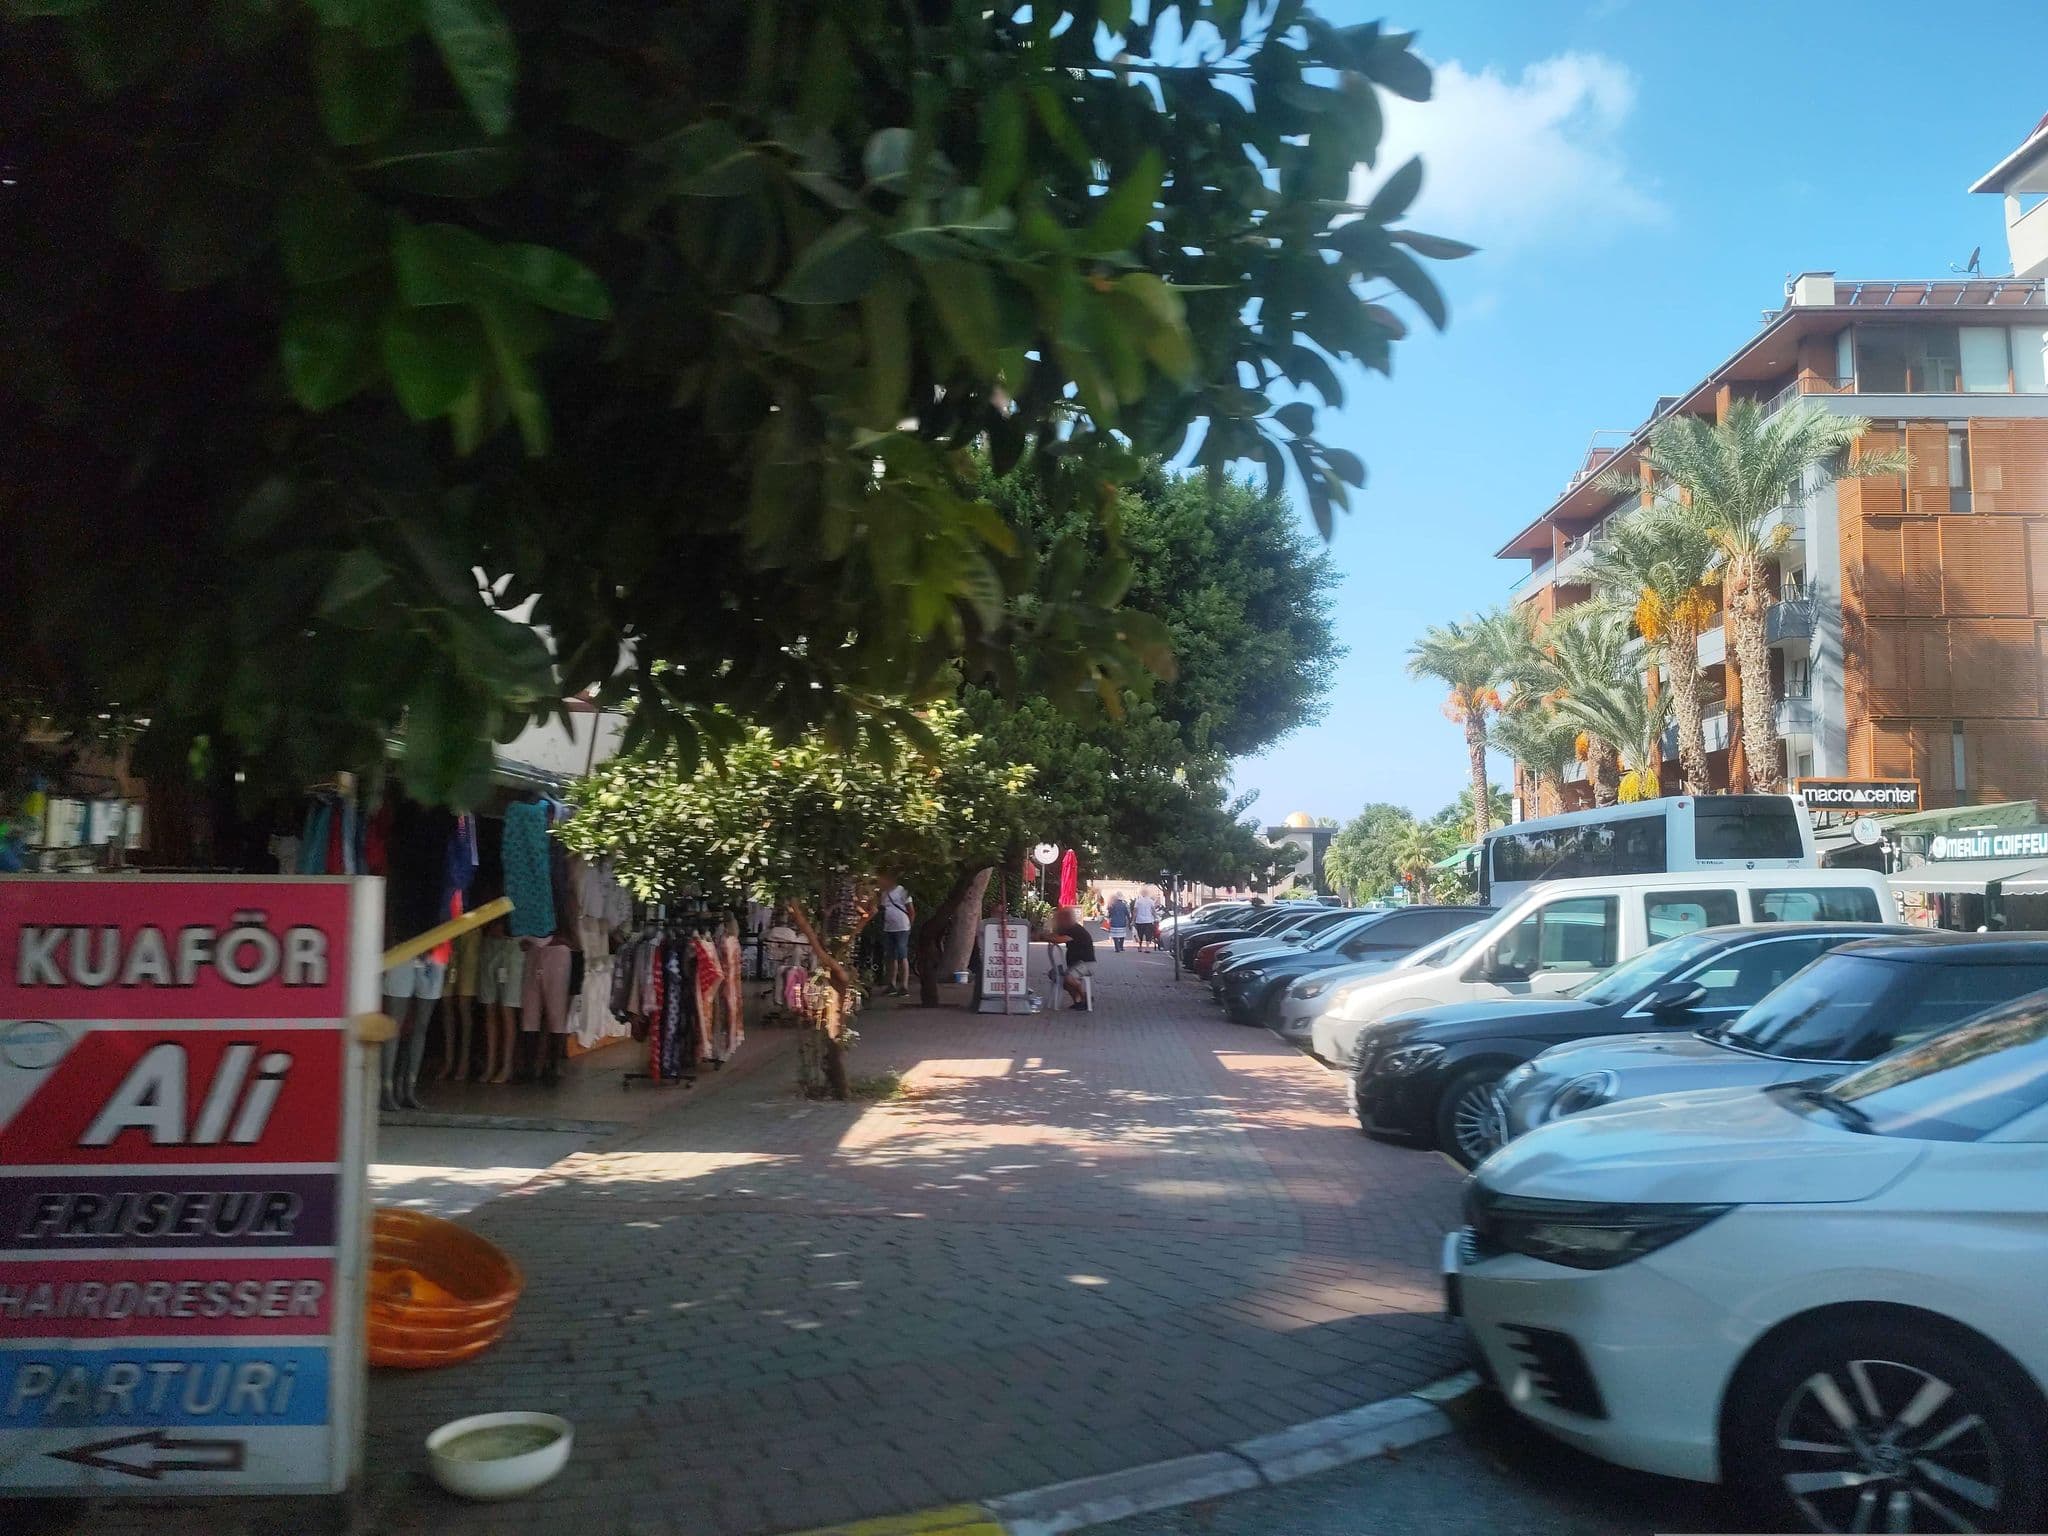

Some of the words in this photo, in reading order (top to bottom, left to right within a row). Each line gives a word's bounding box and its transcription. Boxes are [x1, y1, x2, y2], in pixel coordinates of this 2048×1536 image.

[16, 908, 329, 989] KUAFÖR
[76, 1040, 295, 1148] Ali
[18, 1192, 303, 1238] FRISEUR
[0, 1279, 324, 1319] HAIRDRESSER
